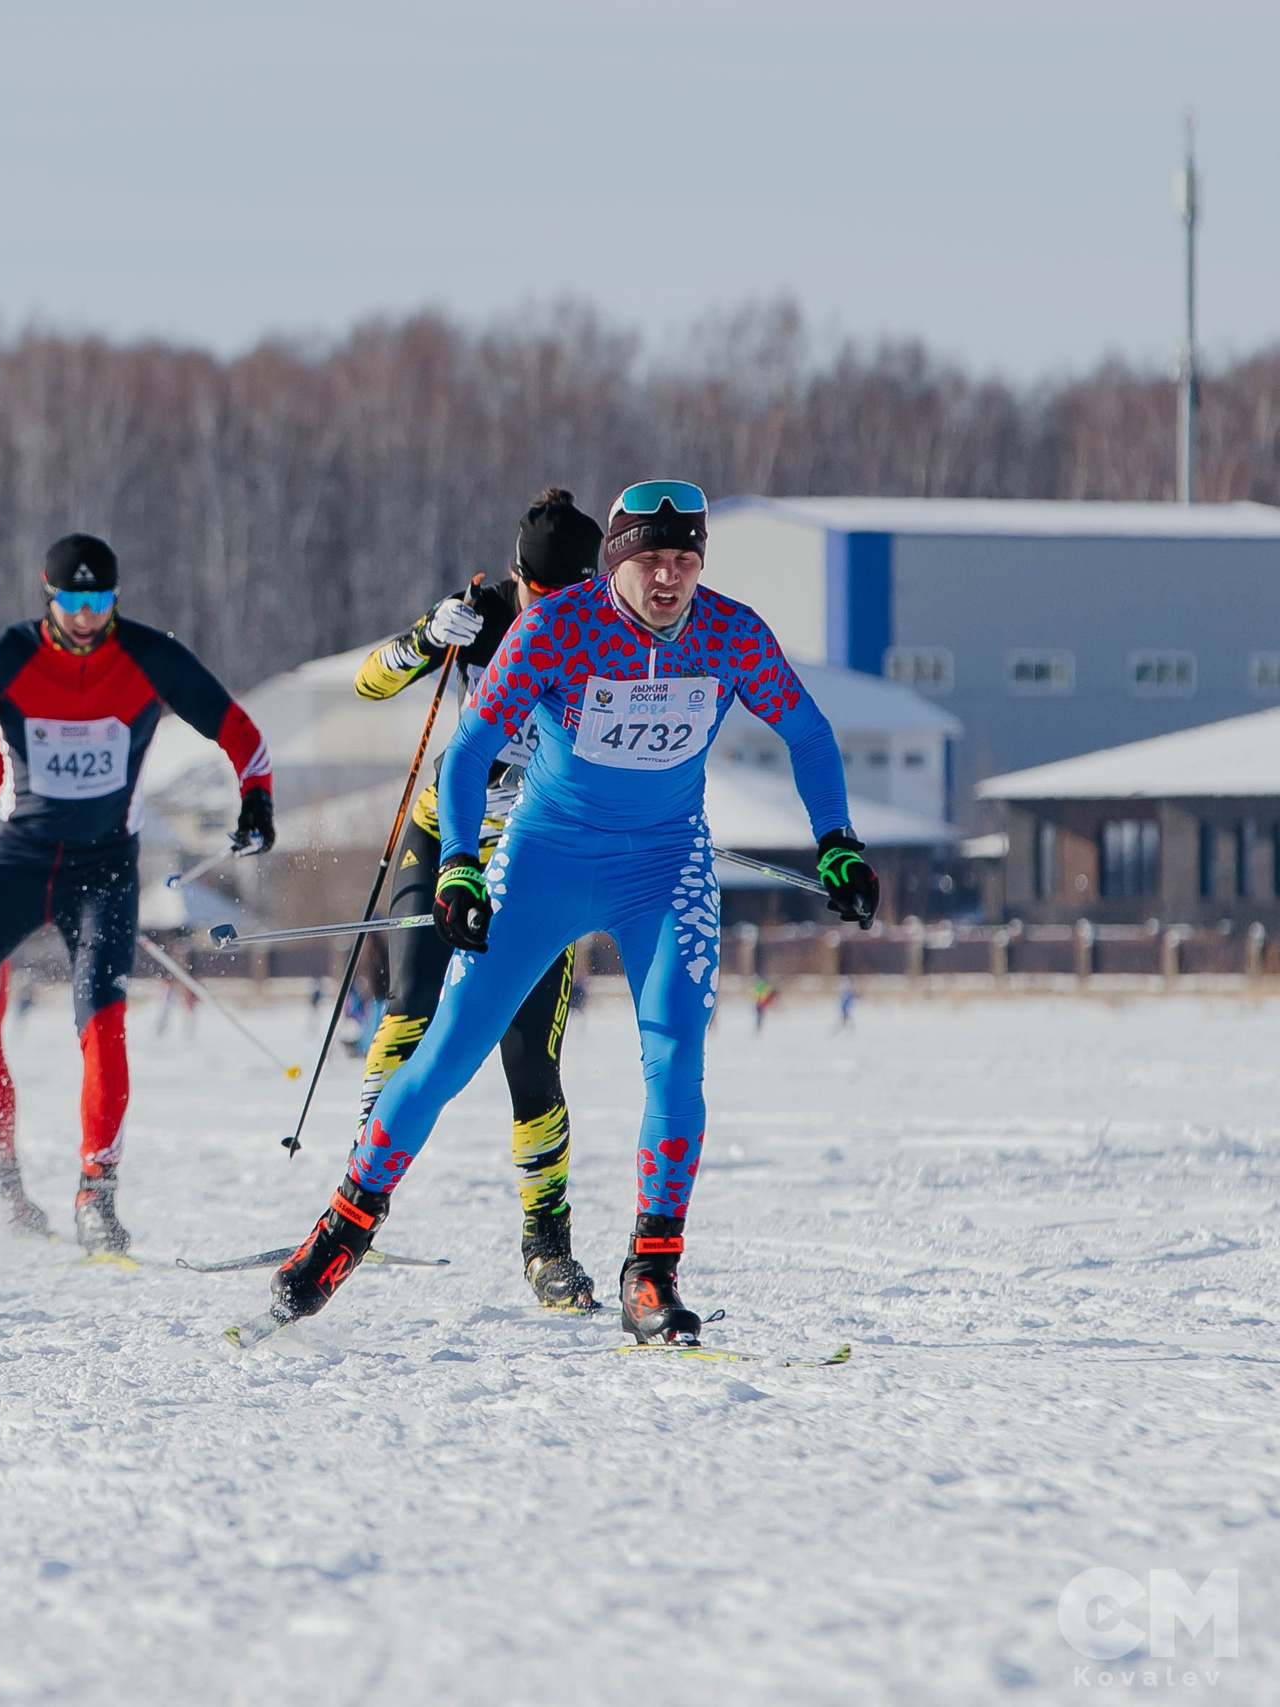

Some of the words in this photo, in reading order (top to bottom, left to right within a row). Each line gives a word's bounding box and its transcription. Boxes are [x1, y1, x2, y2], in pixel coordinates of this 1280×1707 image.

[630, 684, 668, 694] ЛЫЖНЯ
[630, 693, 668, 702] РОССИИ
[629, 703, 667, 714] 2024
[601, 723, 693, 751] 4732
[47, 750, 113, 778] 4423
[547, 941, 575, 1060] FISCHE
